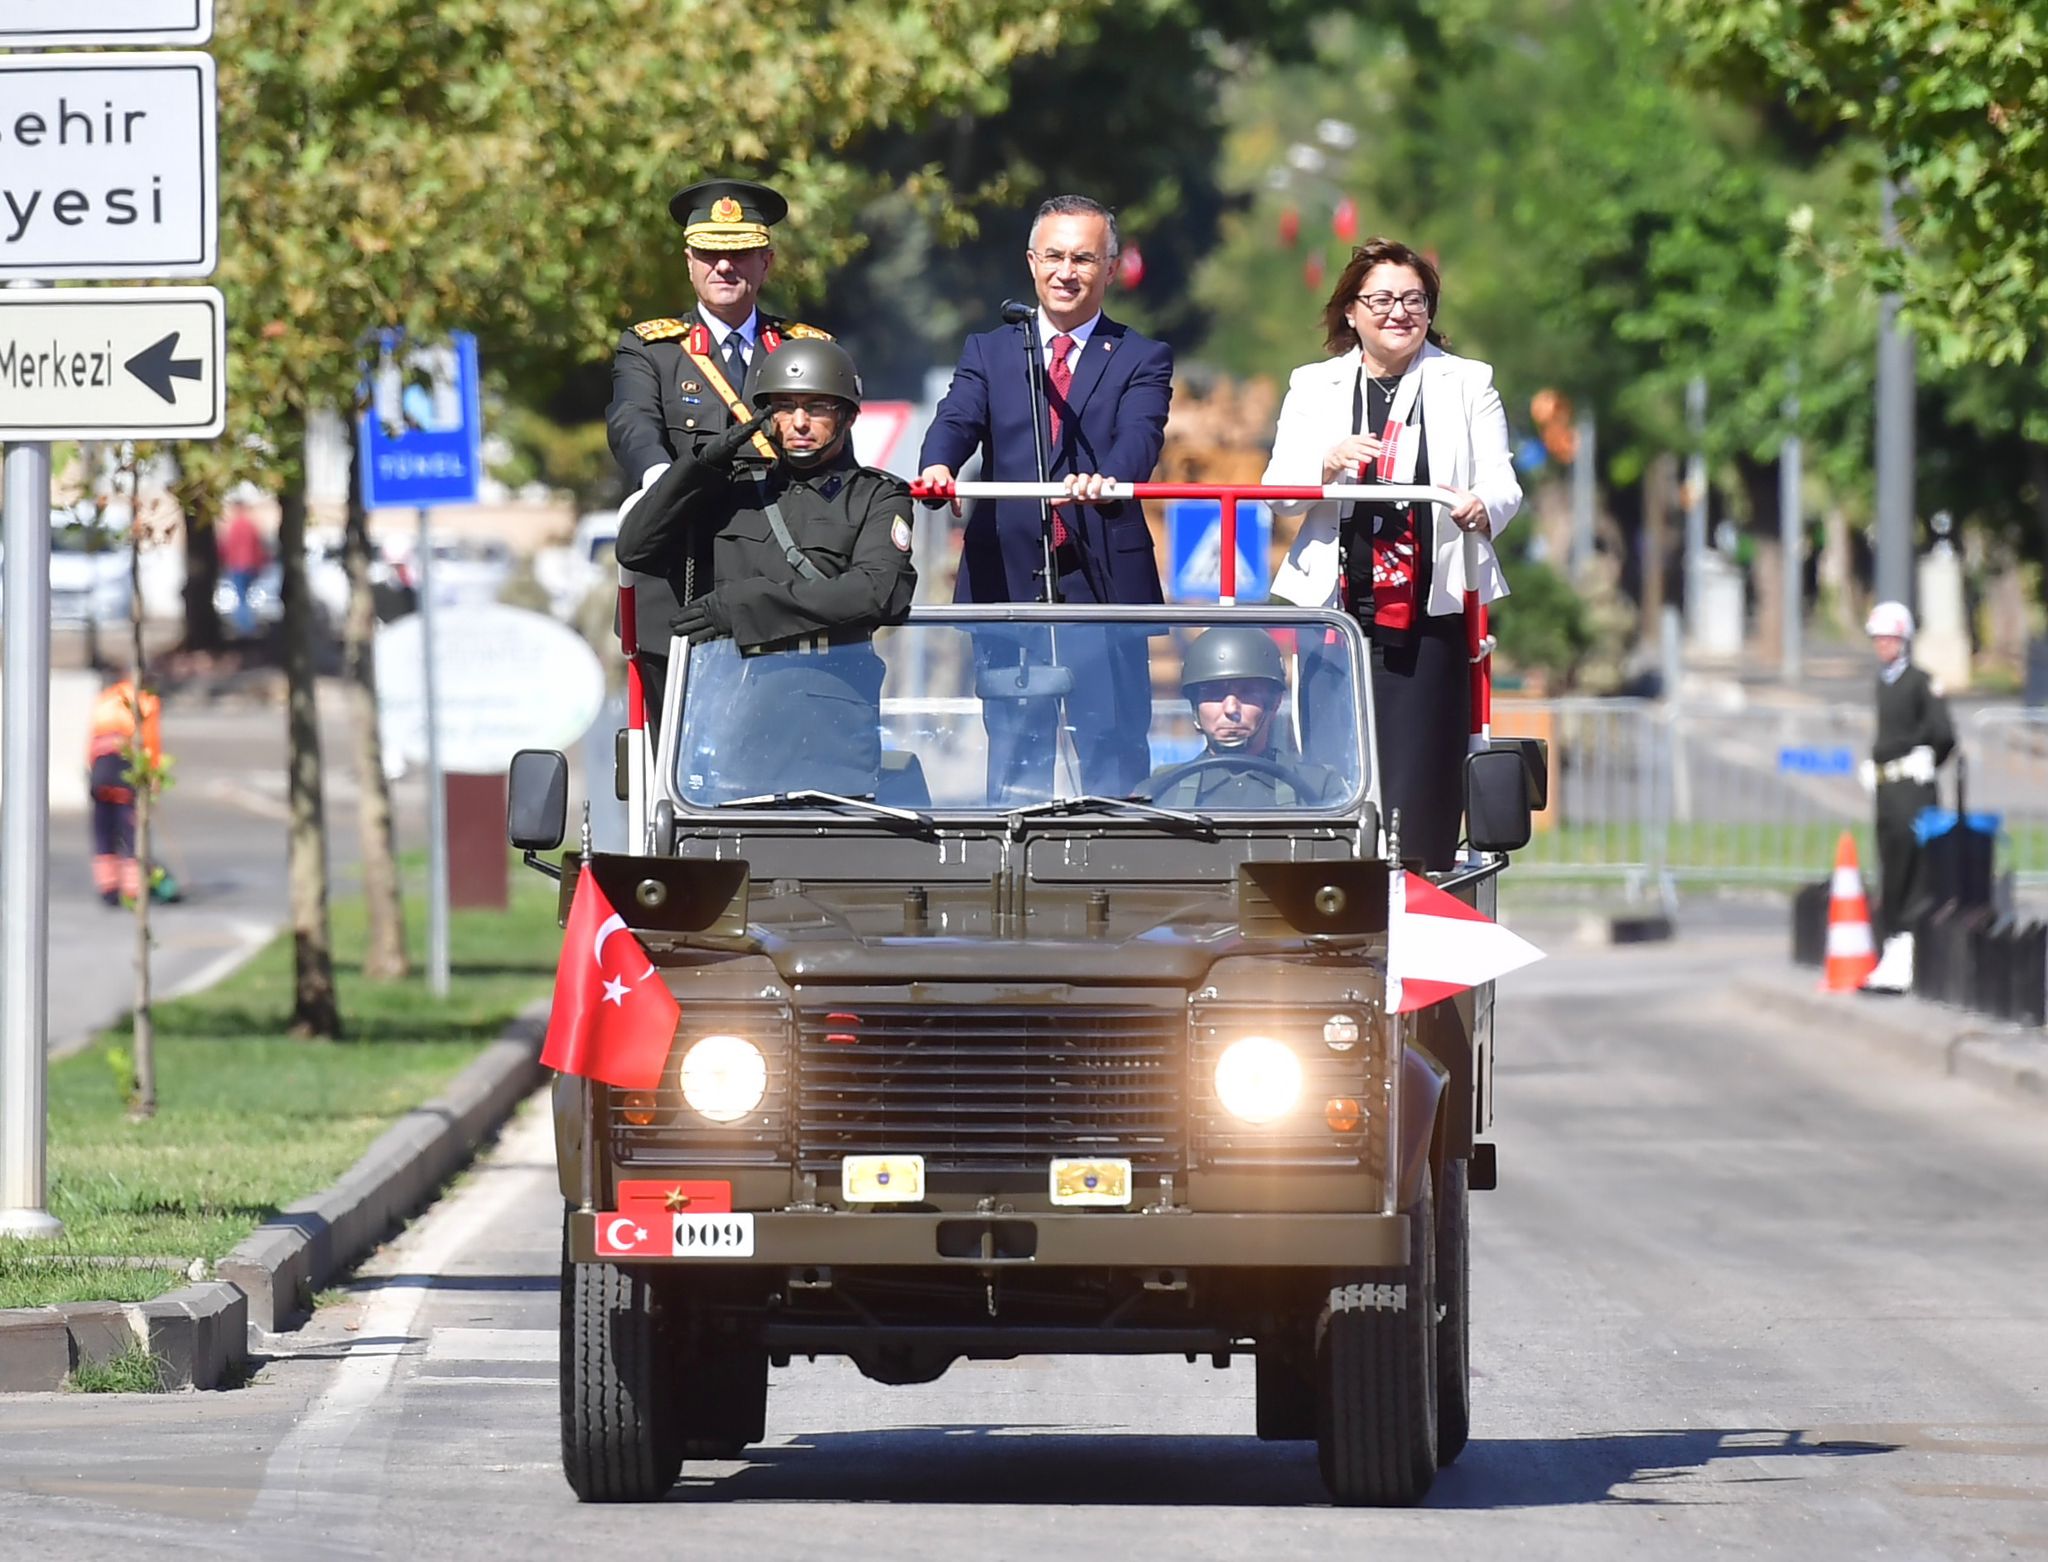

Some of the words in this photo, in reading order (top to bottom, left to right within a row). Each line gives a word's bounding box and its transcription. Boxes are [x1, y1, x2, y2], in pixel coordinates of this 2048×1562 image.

[0, 97, 147, 147] ehir
[0, 338, 112, 389] Merkezi
[675, 1223, 743, 1247] 009
